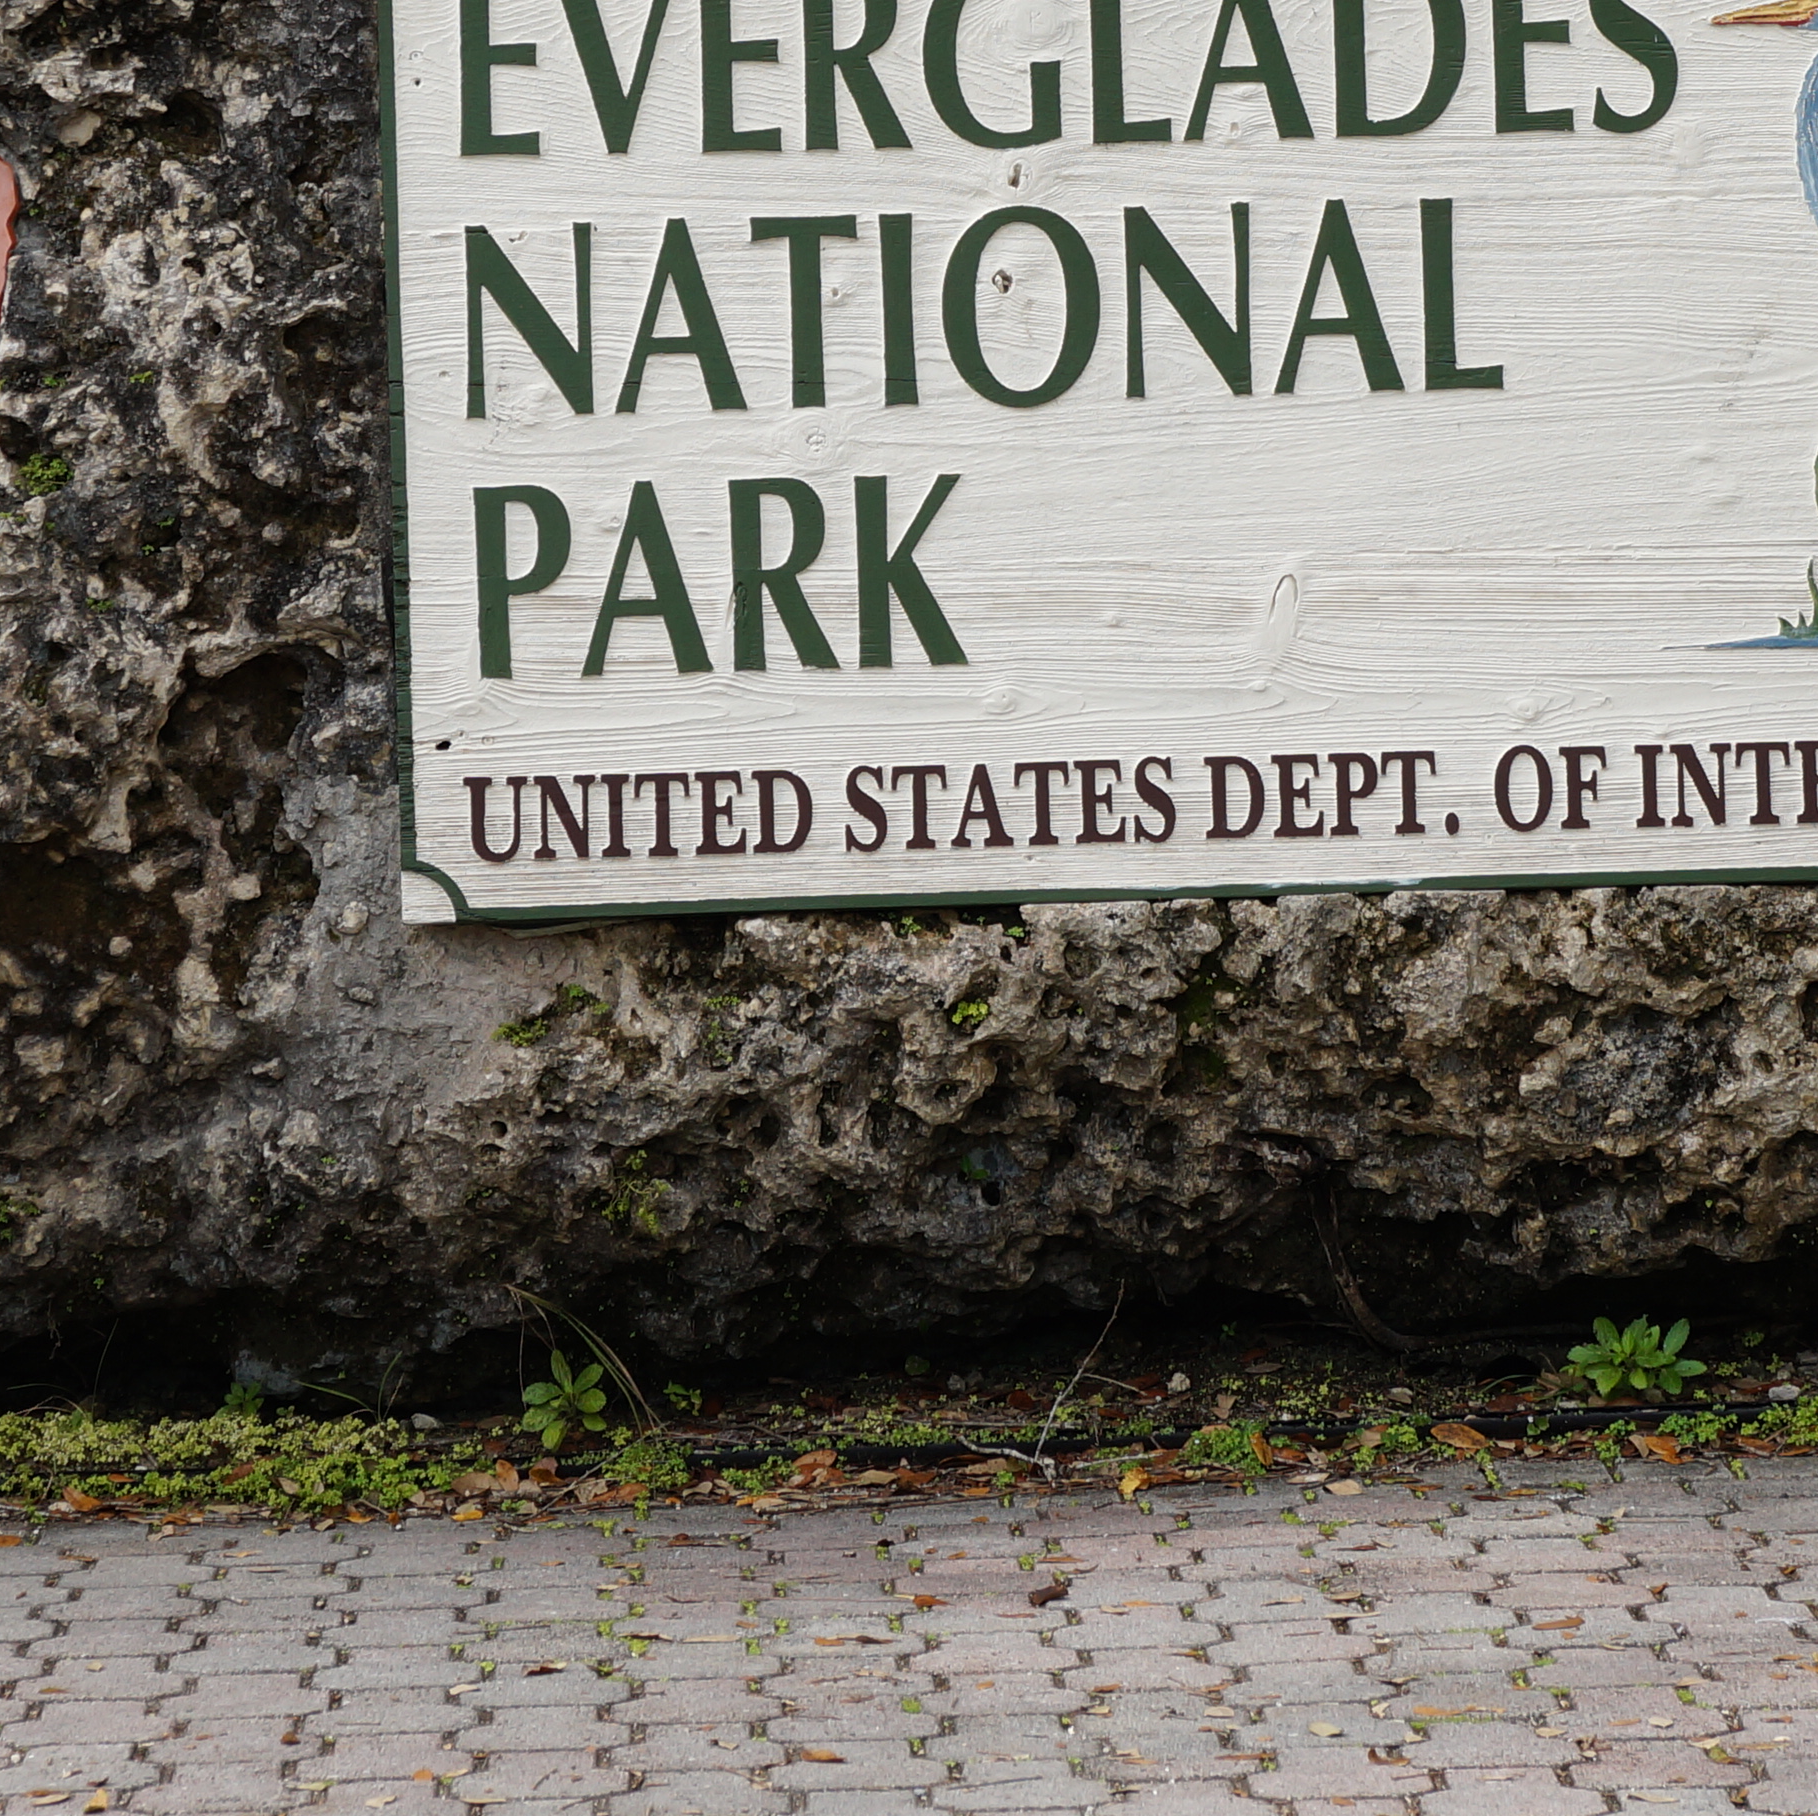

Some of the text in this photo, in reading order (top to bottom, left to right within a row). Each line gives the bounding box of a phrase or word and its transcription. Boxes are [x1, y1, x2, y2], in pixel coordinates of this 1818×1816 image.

[465, 197, 1505, 420] NATIONAL
[472, 473, 969, 680] PARK
[462, 768, 814, 865] UNITED
[844, 755, 1177, 854] STATES
[1202, 749, 1460, 841] DEPT.
[1493, 743, 1608, 834] OF
